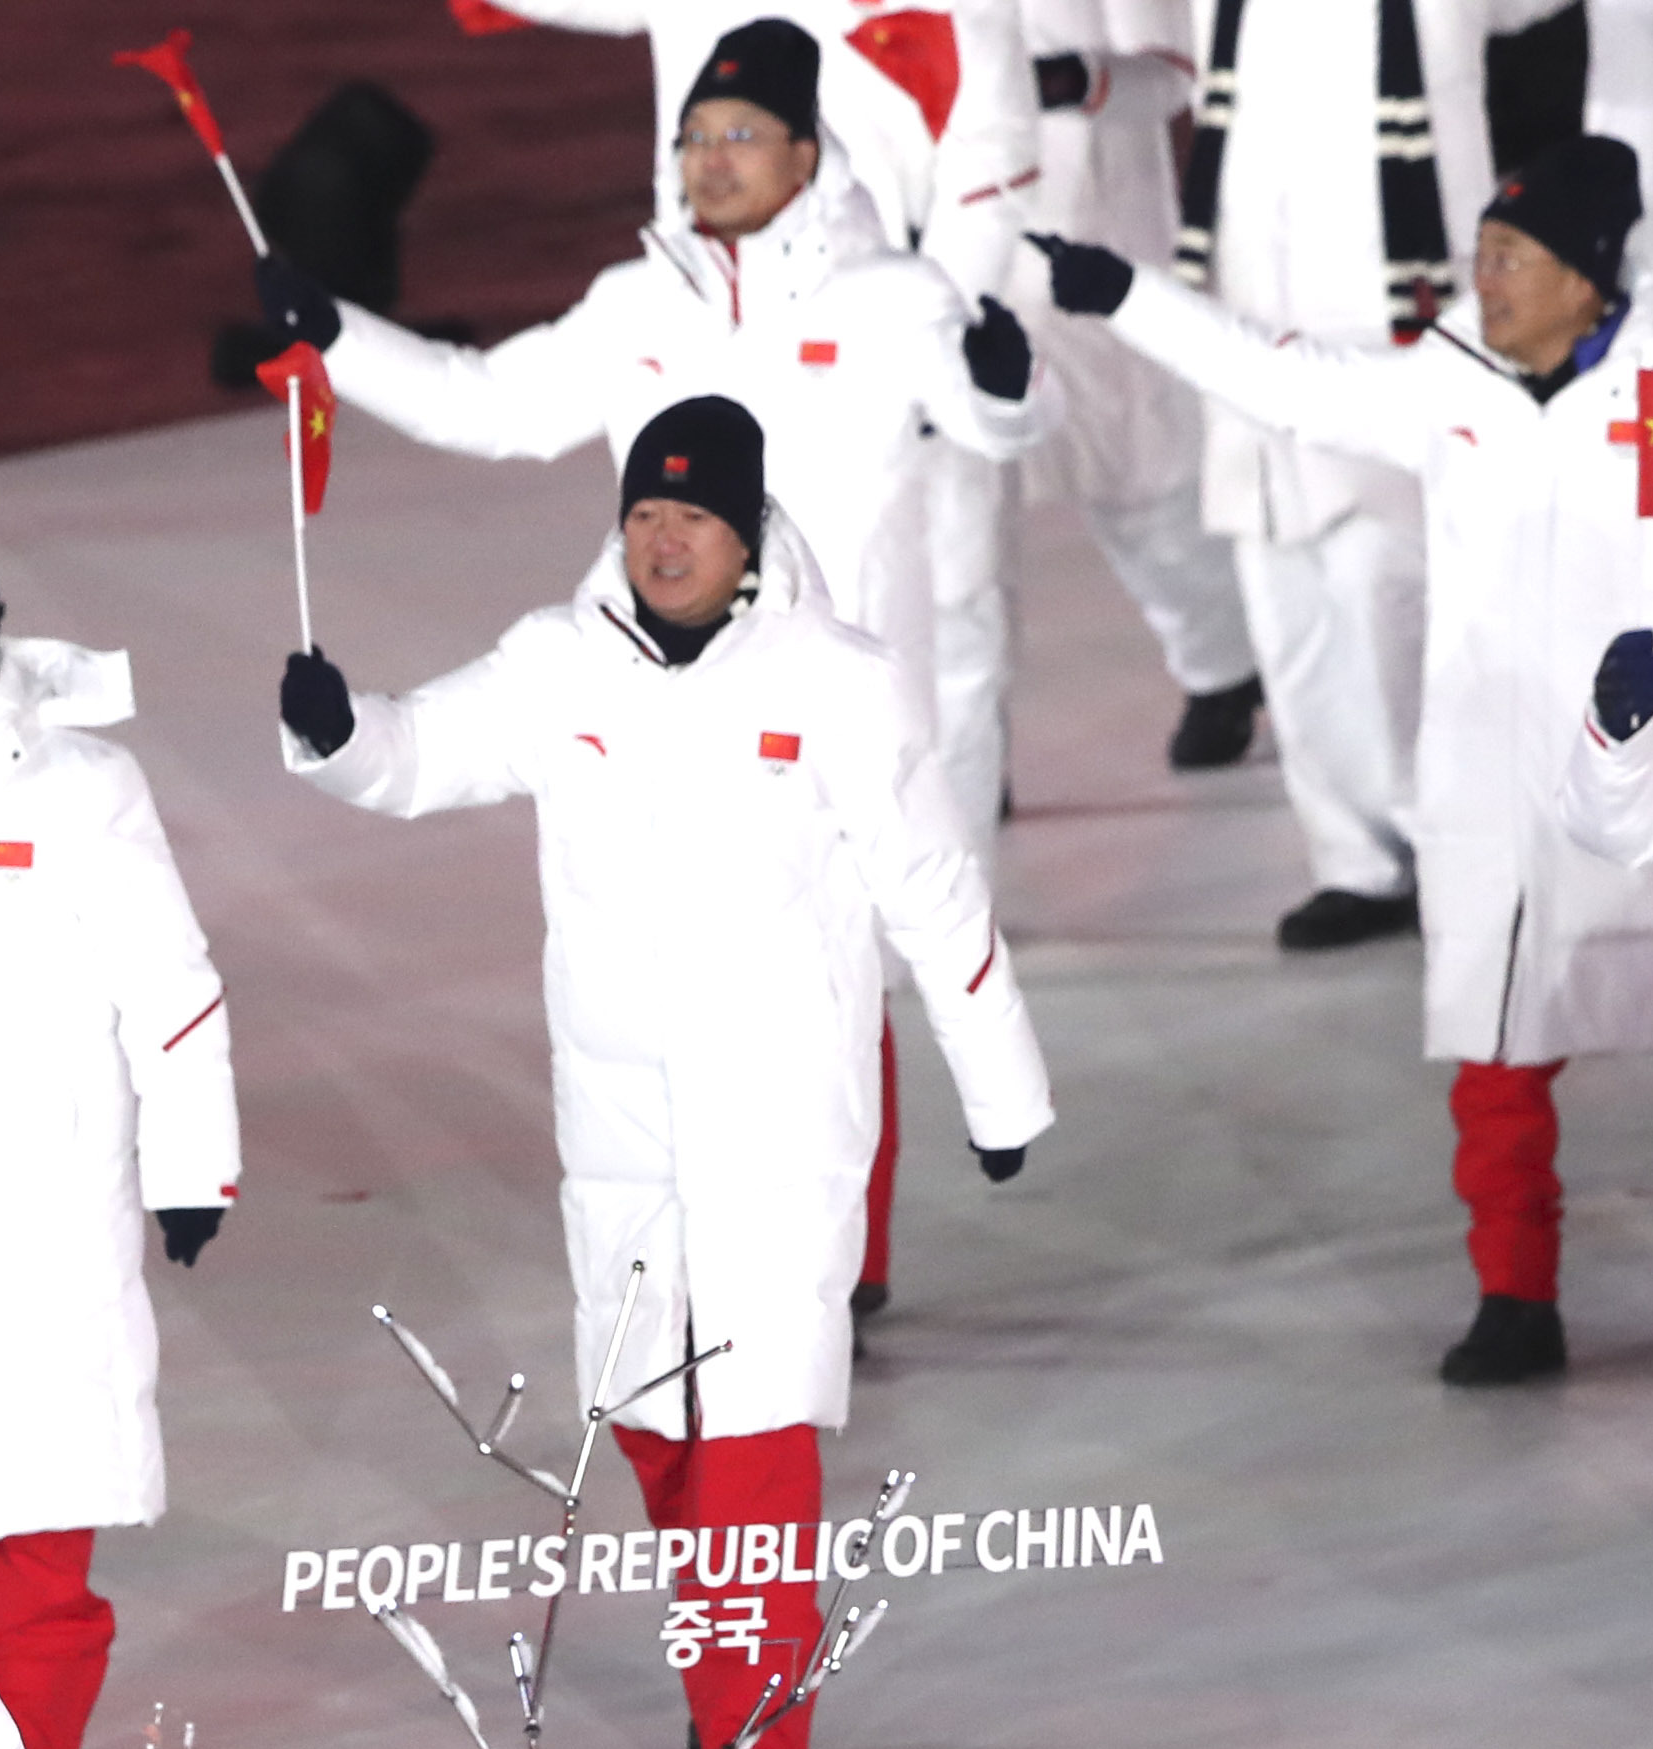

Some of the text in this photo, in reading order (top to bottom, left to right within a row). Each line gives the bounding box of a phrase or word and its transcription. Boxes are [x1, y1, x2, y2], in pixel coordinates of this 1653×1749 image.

[281, 1503, 1164, 1612] PEOPLE'S REPUBLIC OF CHINA
[660, 1597, 769, 1669] 중국
